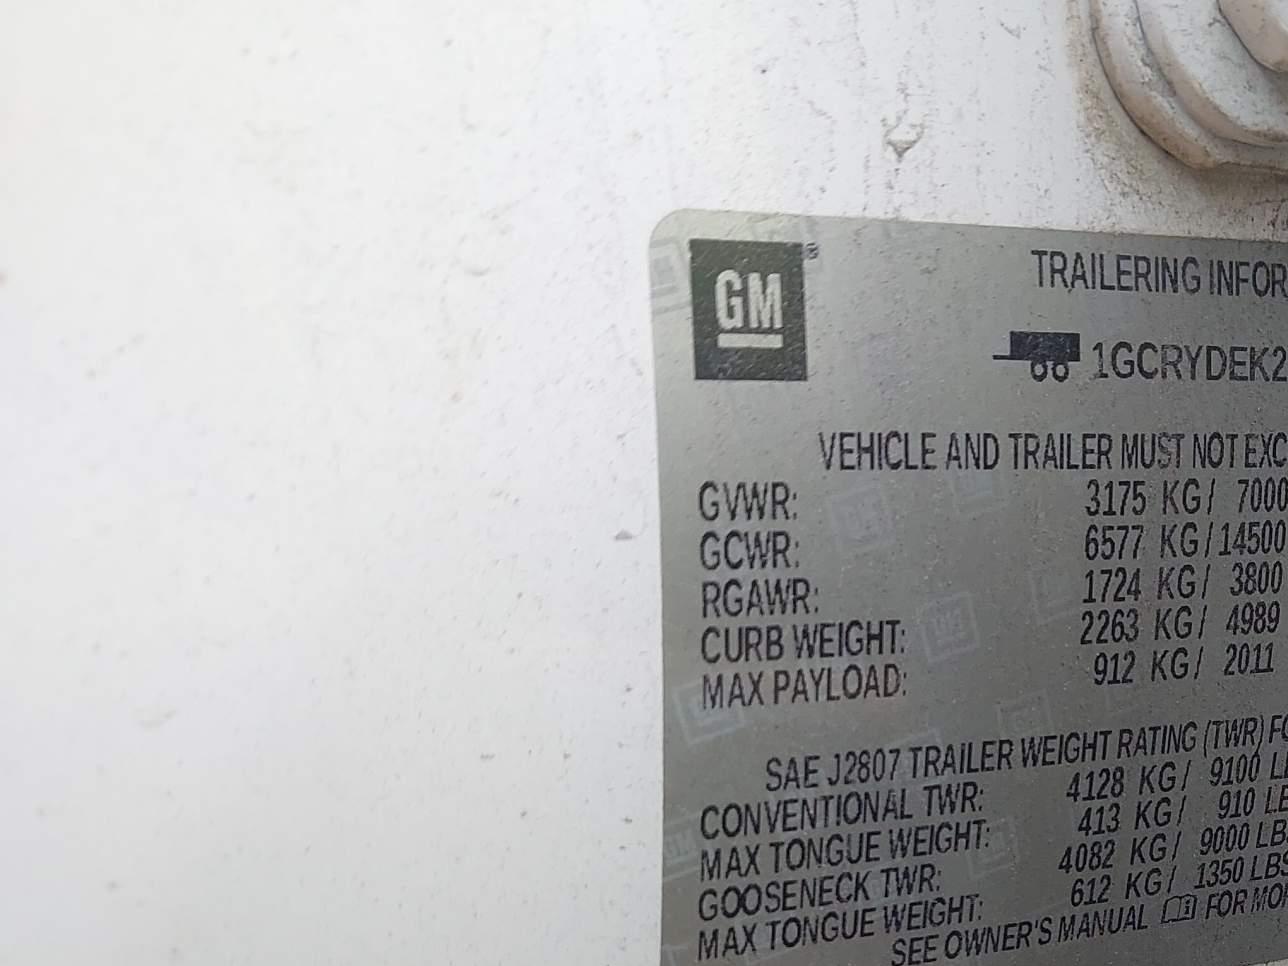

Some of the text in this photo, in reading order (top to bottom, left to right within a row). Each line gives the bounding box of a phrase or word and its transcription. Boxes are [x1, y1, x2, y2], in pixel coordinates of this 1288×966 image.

[715, 270, 783, 330] GM
[1031, 249, 1200, 295] TRAILERING
[818, 431, 937, 470] VEHICLE
[945, 432, 1000, 470] AND
[1007, 432, 1113, 470] TRAILER
[1121, 433, 1184, 469] MUST
[1192, 433, 1239, 469] NOT
[699, 480, 798, 521] GVWR:
[1084, 481, 1146, 517] 3175
[1237, 478, 1288, 513] 7000
[700, 529, 799, 570] GCWR:
[1083, 524, 1145, 561] 6577
[701, 577, 819, 618] RGAWR:
[1081, 567, 1141, 603] 1724
[1229, 562, 1282, 595] 3800
[701, 626, 784, 664] CURB
[793, 619, 906, 658] WEIGHT:
[1080, 609, 1139, 645] 2263
[1225, 601, 1280, 636] 4989
[702, 671, 765, 710] MAX
[773, 663, 907, 704] PAYLOAD:
[1094, 651, 1136, 686] 912
[1224, 642, 1275, 676] 2011
[766, 754, 820, 792] SAE
[827, 747, 901, 787] J2807
[909, 738, 1013, 779] TRAILER
[1020, 730, 1112, 770] WEIGHT
[1117, 720, 1198, 760] RATING
[1203, 716, 1265, 757] (TWR)
[700, 791, 913, 840] CONVENTIONAL
[923, 780, 984, 816] TWR:
[1066, 766, 1125, 802] 4128
[1209, 752, 1260, 787] 9100
[700, 844, 760, 882] MAX
[769, 829, 881, 874] TONGUE
[888, 818, 990, 860] WEIGHT:
[1077, 803, 1120, 837] 413
[1218, 787, 1255, 820] 910
[698, 869, 871, 922] GOOSENECK
[879, 862, 942, 897] TWR:
[1058, 840, 1116, 876] 4082
[1199, 823, 1250, 857] 9000
[697, 923, 758, 962] MAX
[765, 908, 876, 954] TONGUE
[883, 893, 983, 936] WEIGHT:
[1070, 876, 1116, 908] 612
[1194, 857, 1244, 892] 1350
[944, 916, 1052, 960] OWNER'S
[1057, 904, 1148, 944] MANUAL
[1205, 888, 1247, 920] FOR
